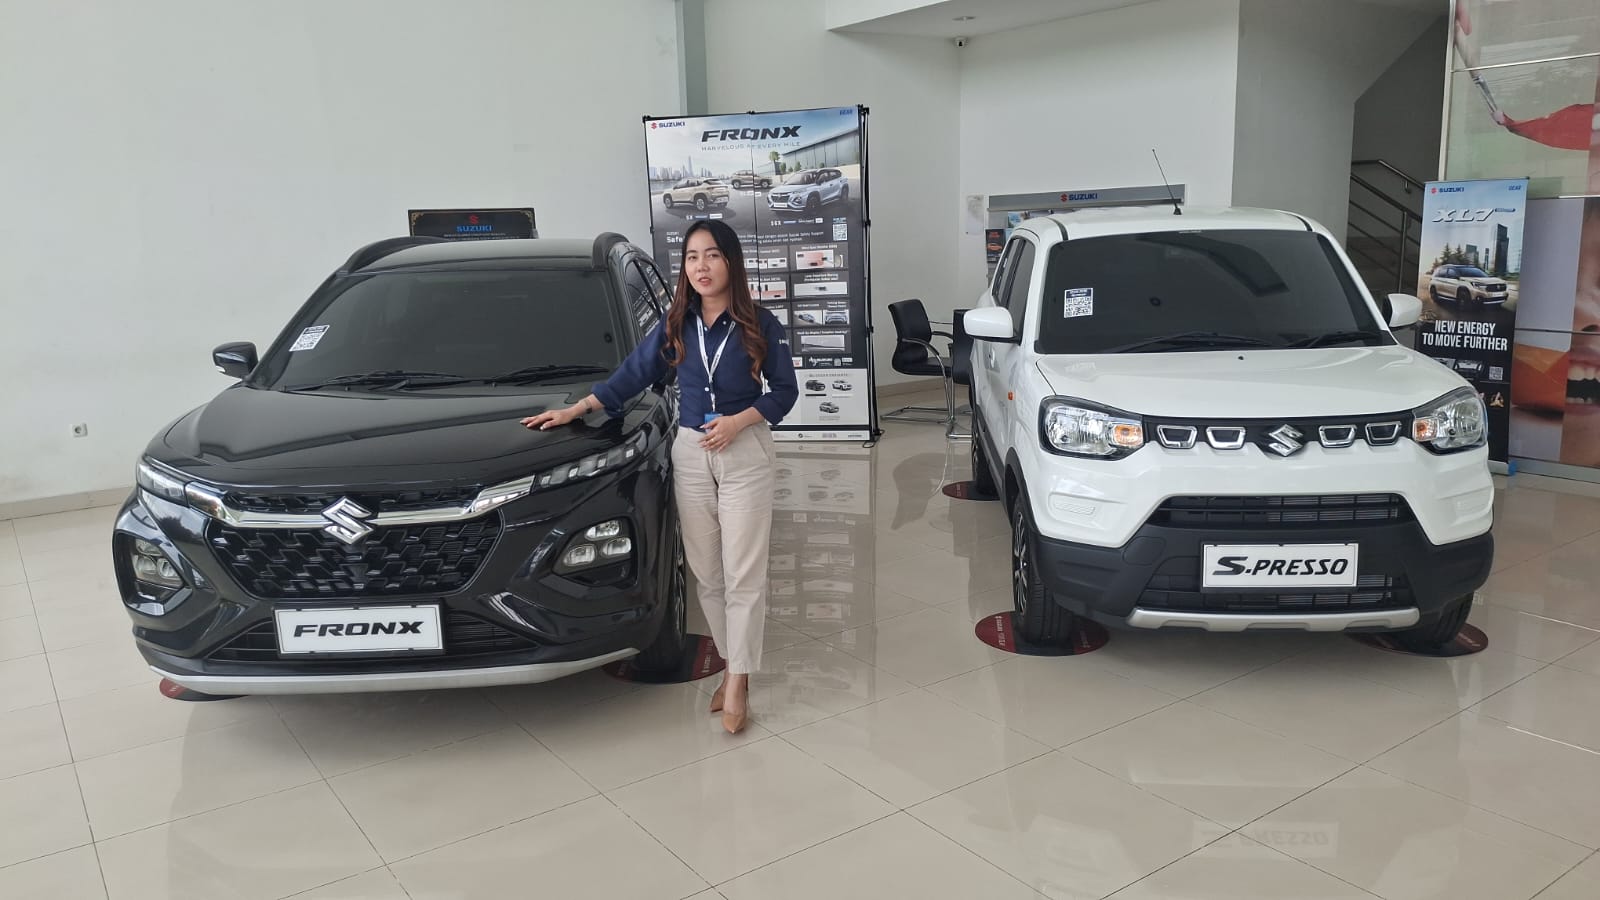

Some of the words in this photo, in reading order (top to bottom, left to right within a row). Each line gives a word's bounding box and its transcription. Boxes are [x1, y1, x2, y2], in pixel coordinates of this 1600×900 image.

[658, 121, 686, 129] SUZUKI
[701, 125, 802, 142] FRONX
[1068, 193, 1098, 201] SUZUKI
[1434, 319, 1456, 334] NEW
[1457, 321, 1496, 336] ENERGY
[1422, 332, 1434, 346] TO
[1434, 333, 1462, 348] MOVE
[1463, 335, 1508, 351] FURTHER
[293, 621, 424, 637] FRONX
